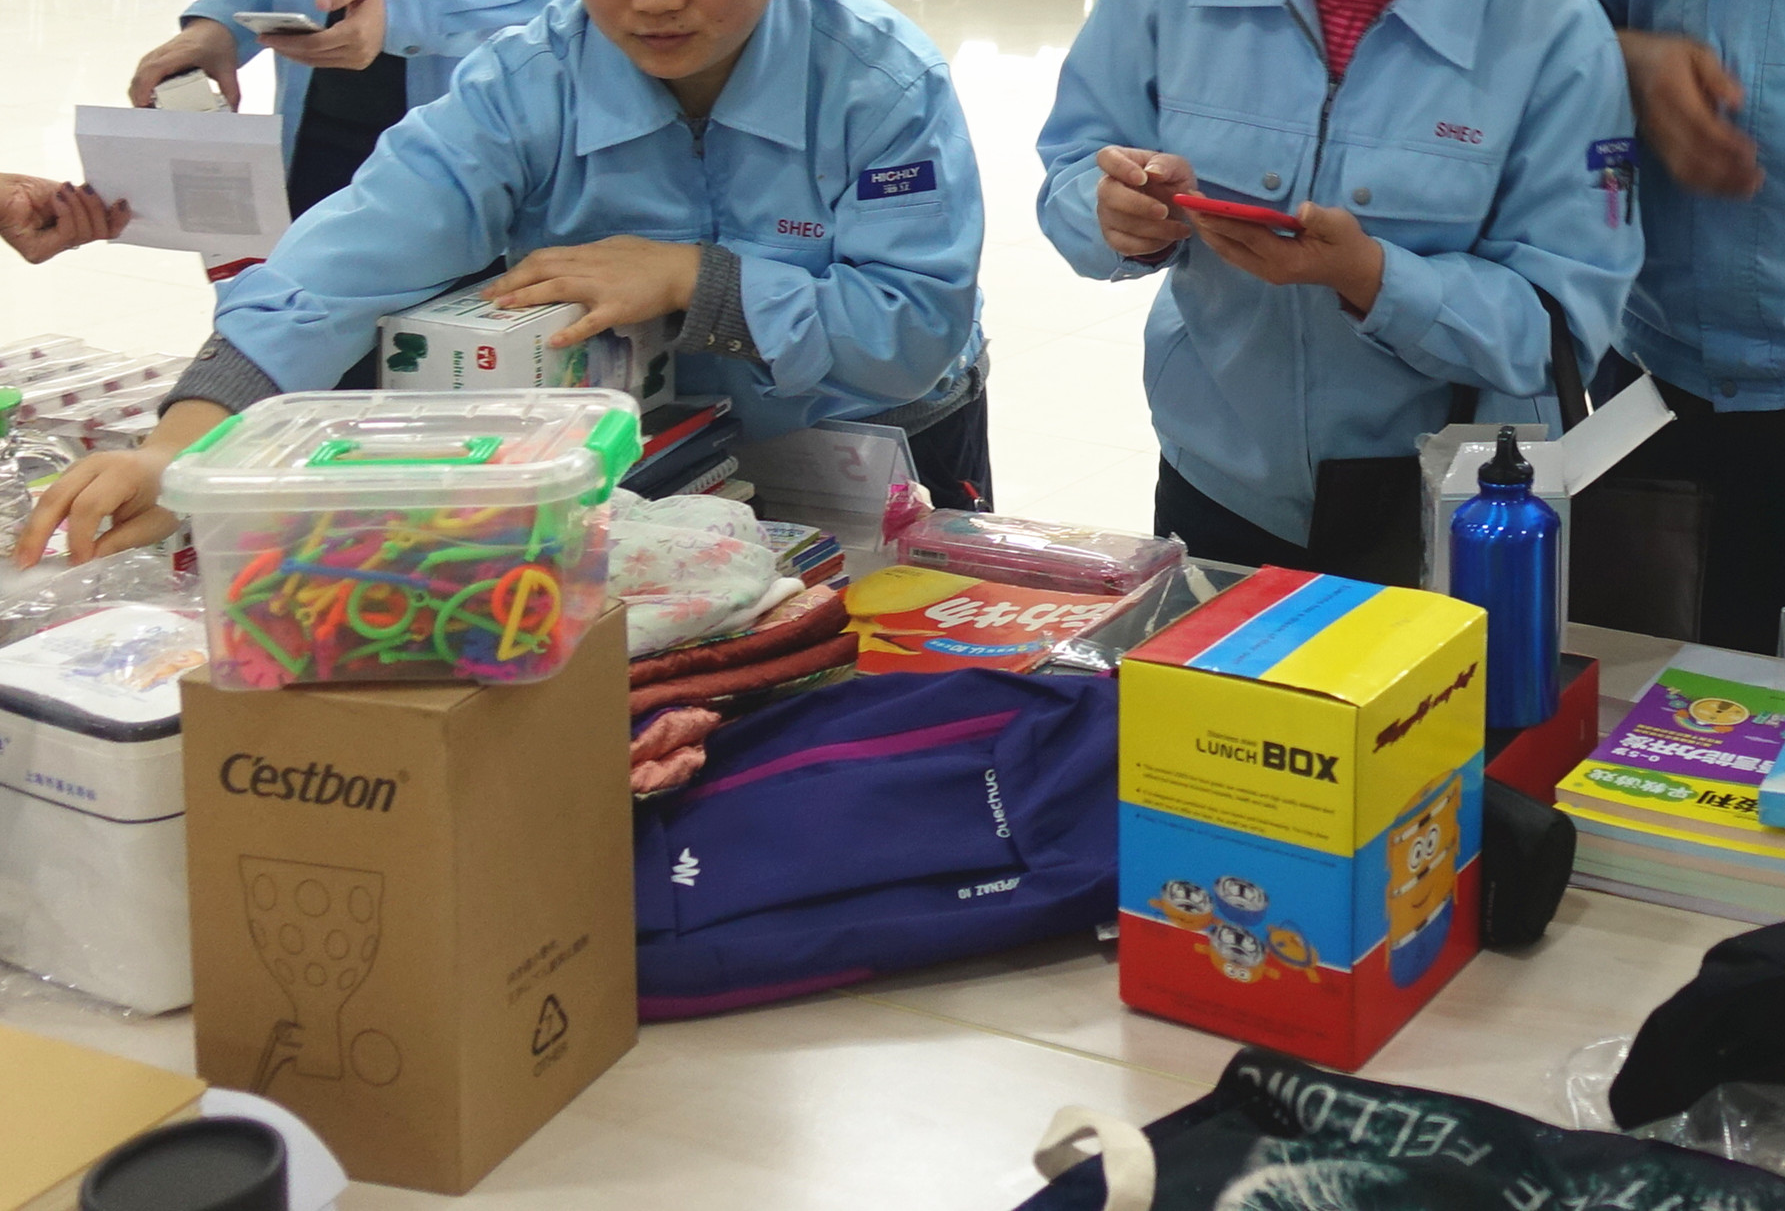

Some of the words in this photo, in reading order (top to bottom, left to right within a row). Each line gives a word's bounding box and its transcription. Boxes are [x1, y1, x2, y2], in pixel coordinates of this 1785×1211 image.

[1434, 121, 1484, 146] SHEC
[871, 166, 921, 184] HIGHLY
[776, 218, 825, 238] SHEC
[1195, 738, 1258, 765] LUNCH
[1262, 740, 1340, 785] BOX
[1588, 768, 1693, 801] 早教游戏
[984, 768, 1012, 839] Quechua
